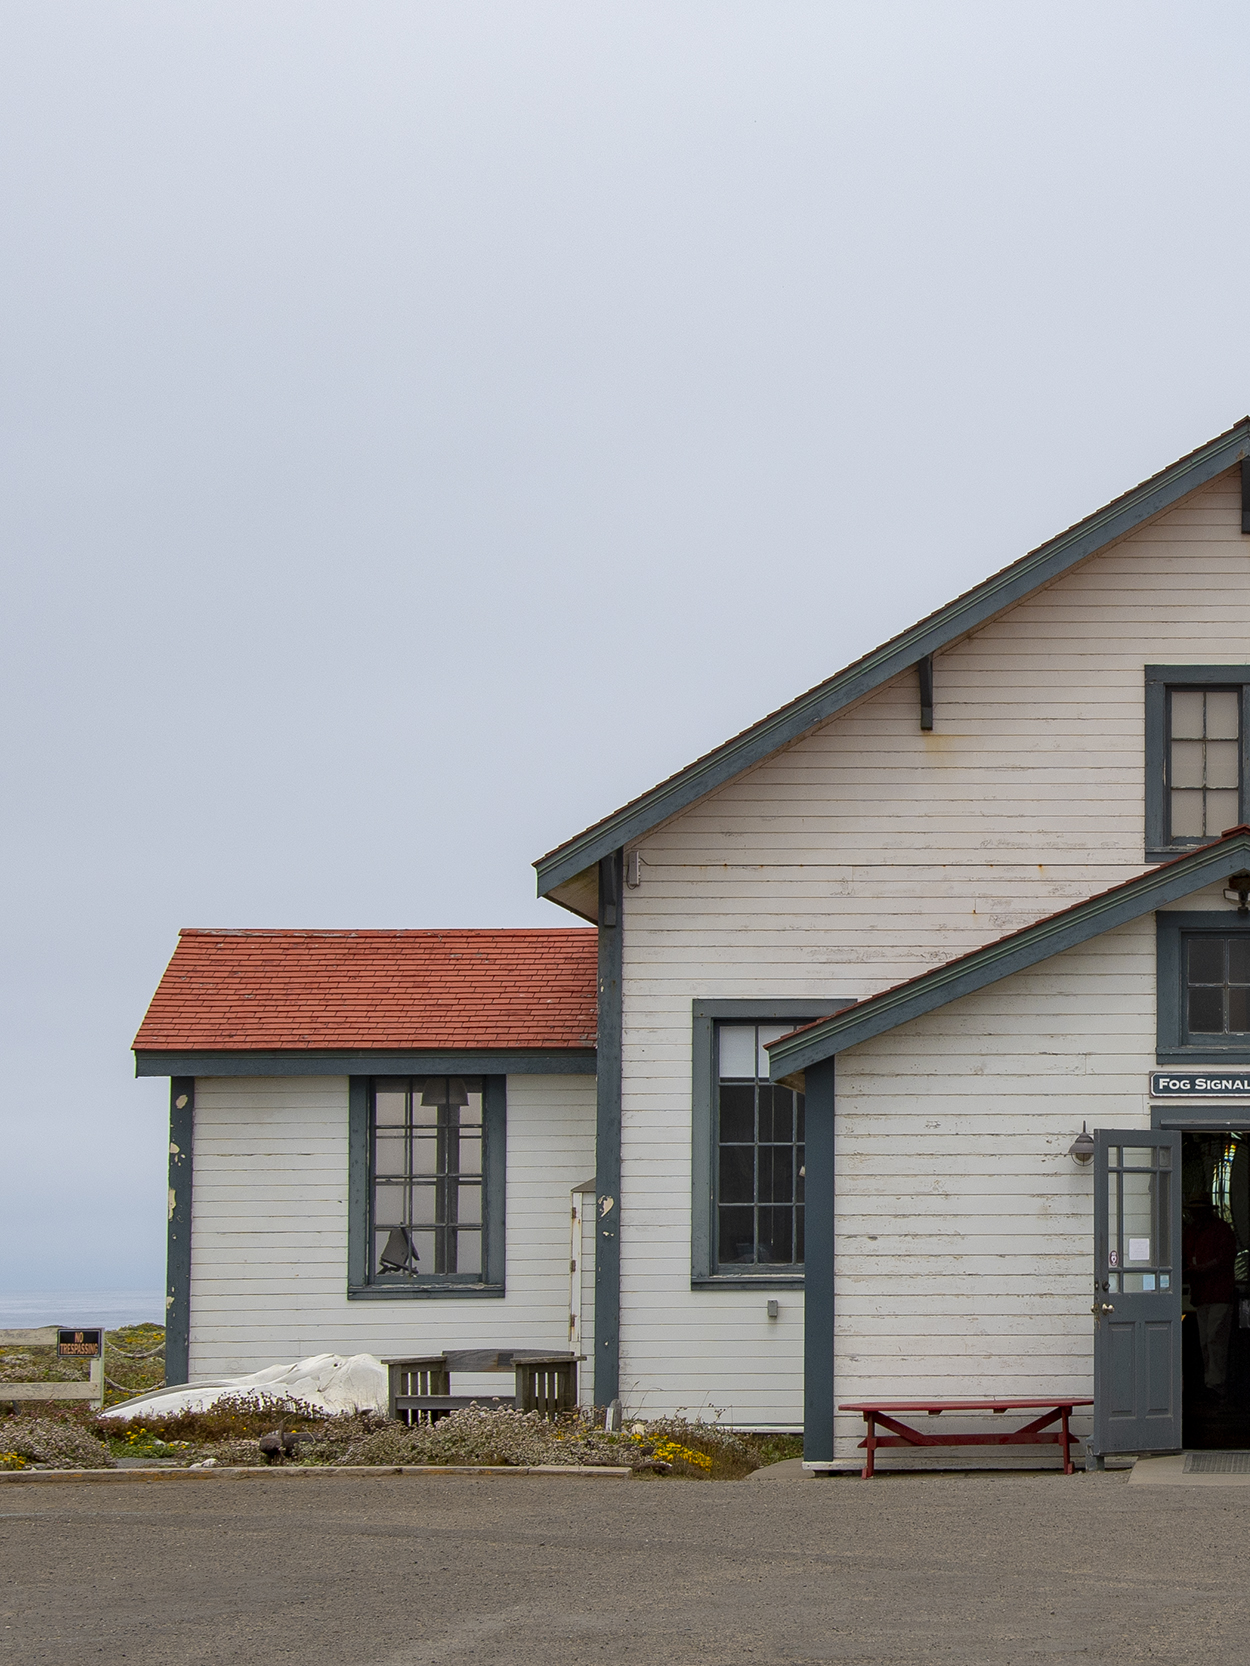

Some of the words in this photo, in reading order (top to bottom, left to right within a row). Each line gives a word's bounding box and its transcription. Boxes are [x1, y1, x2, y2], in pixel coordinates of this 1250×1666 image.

[1158, 1078, 1191, 1090] FOG
[74, 1331, 84, 1343] NO
[60, 1342, 98, 1355] TRESPASSING
